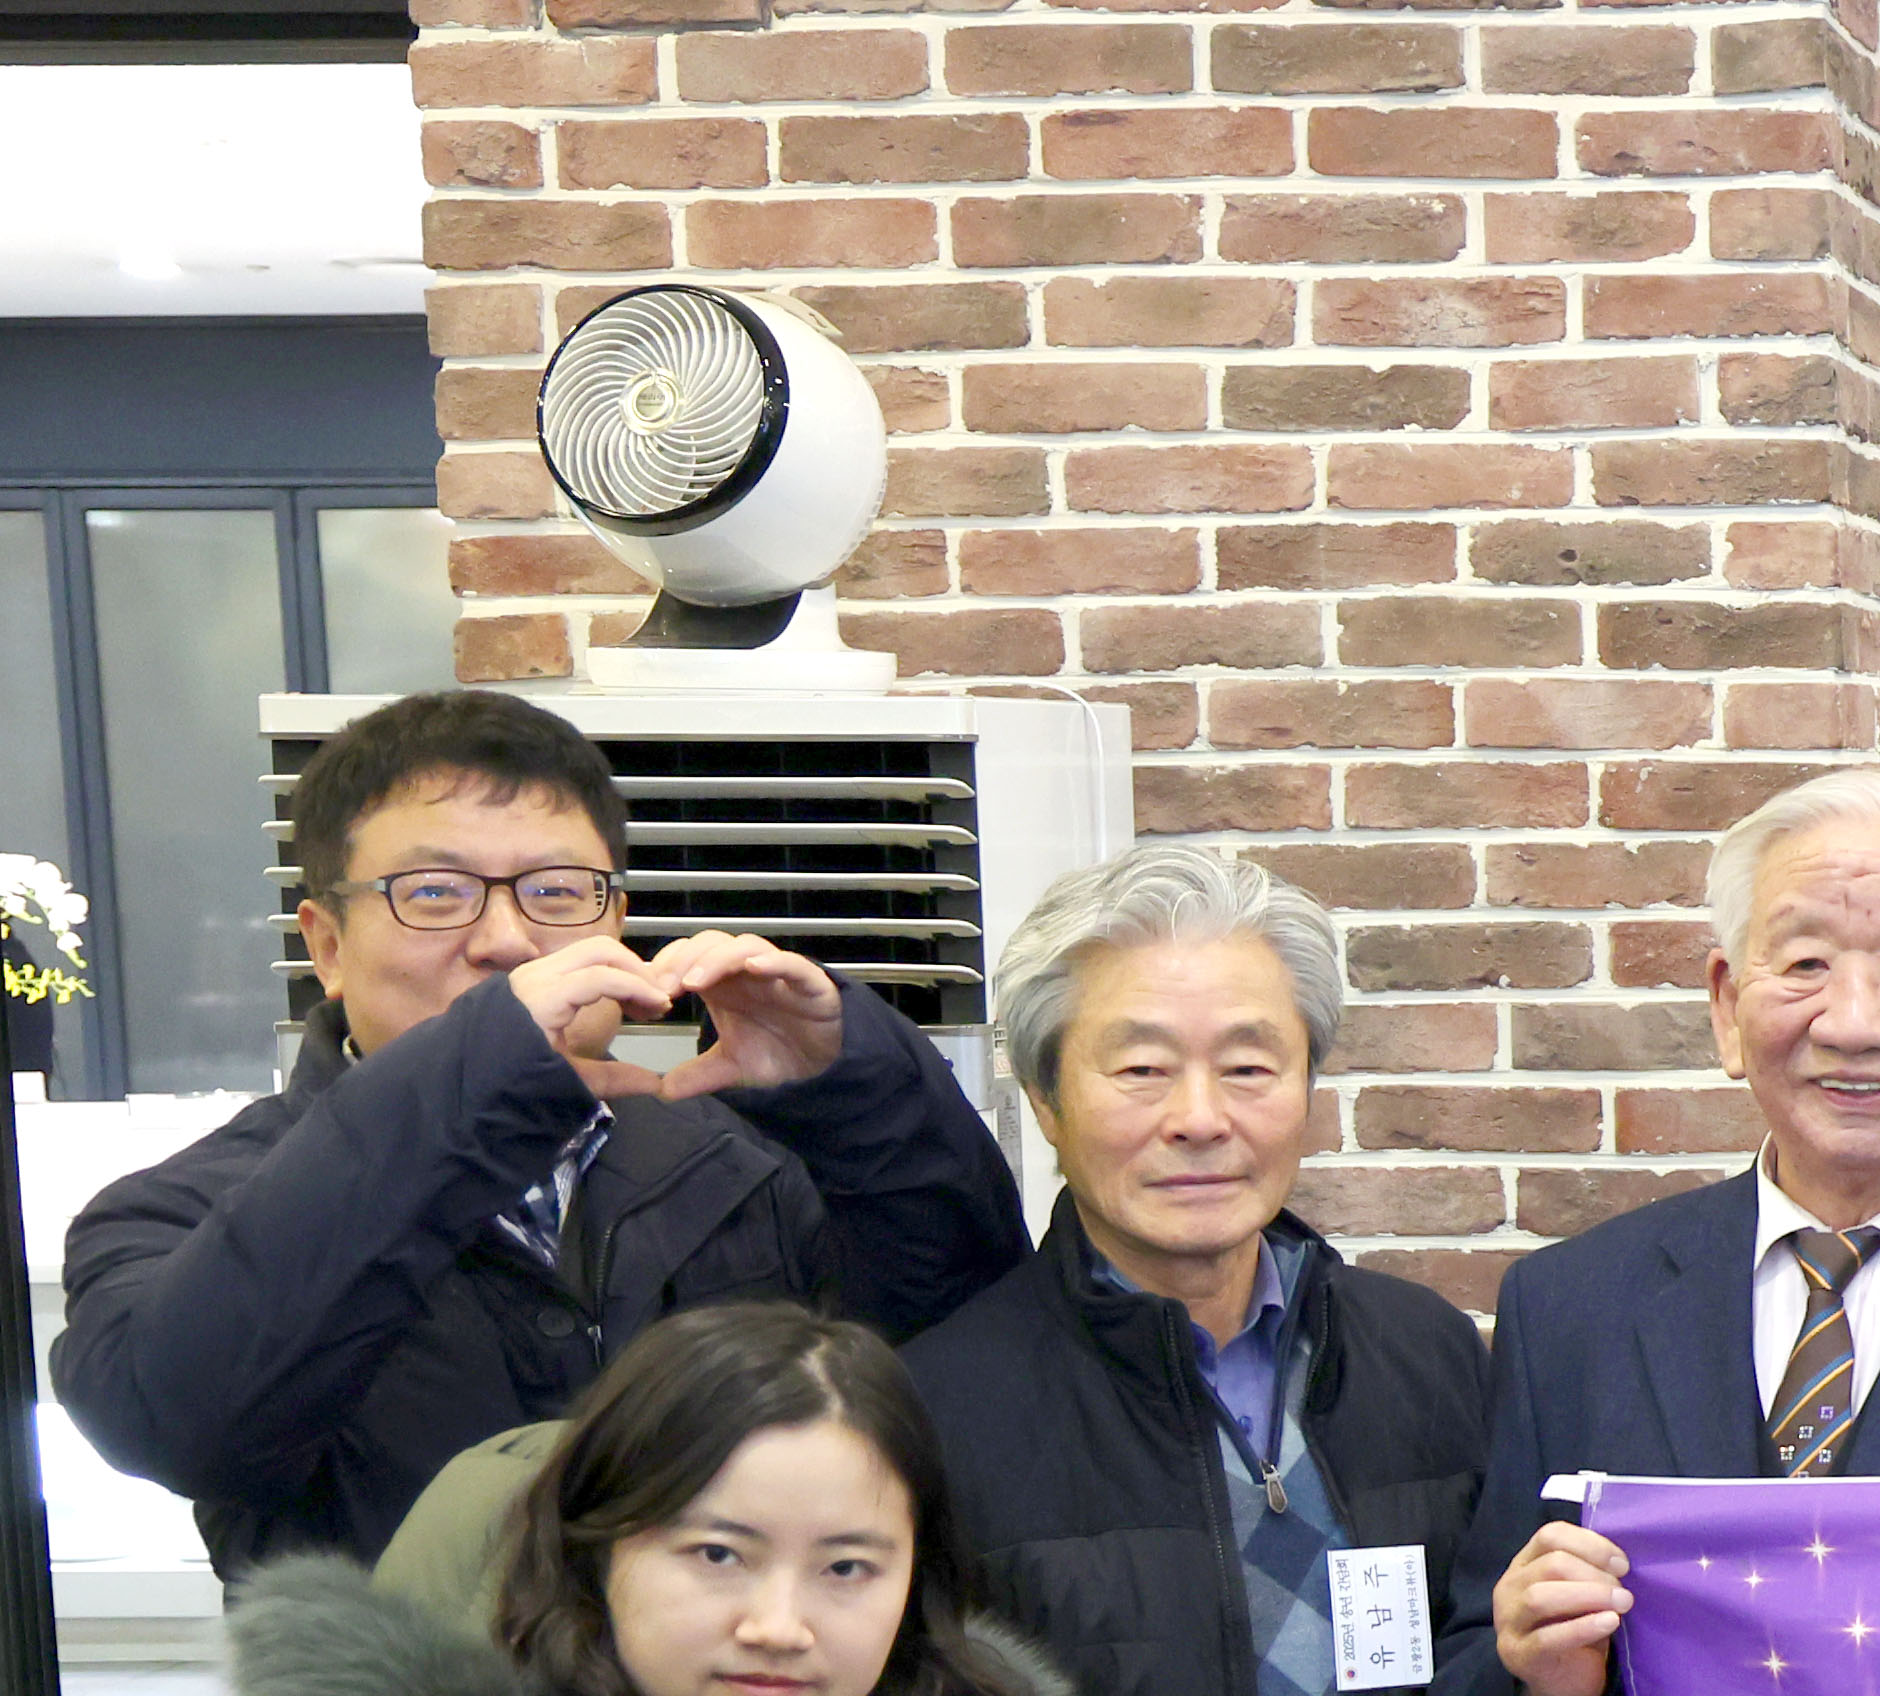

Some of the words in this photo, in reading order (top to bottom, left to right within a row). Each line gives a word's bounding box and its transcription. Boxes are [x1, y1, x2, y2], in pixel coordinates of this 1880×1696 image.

[1336, 1558, 1351, 1592] 간담회
[1338, 1596, 1354, 1619] 송년
[1342, 1624, 1356, 1662] 2025년
